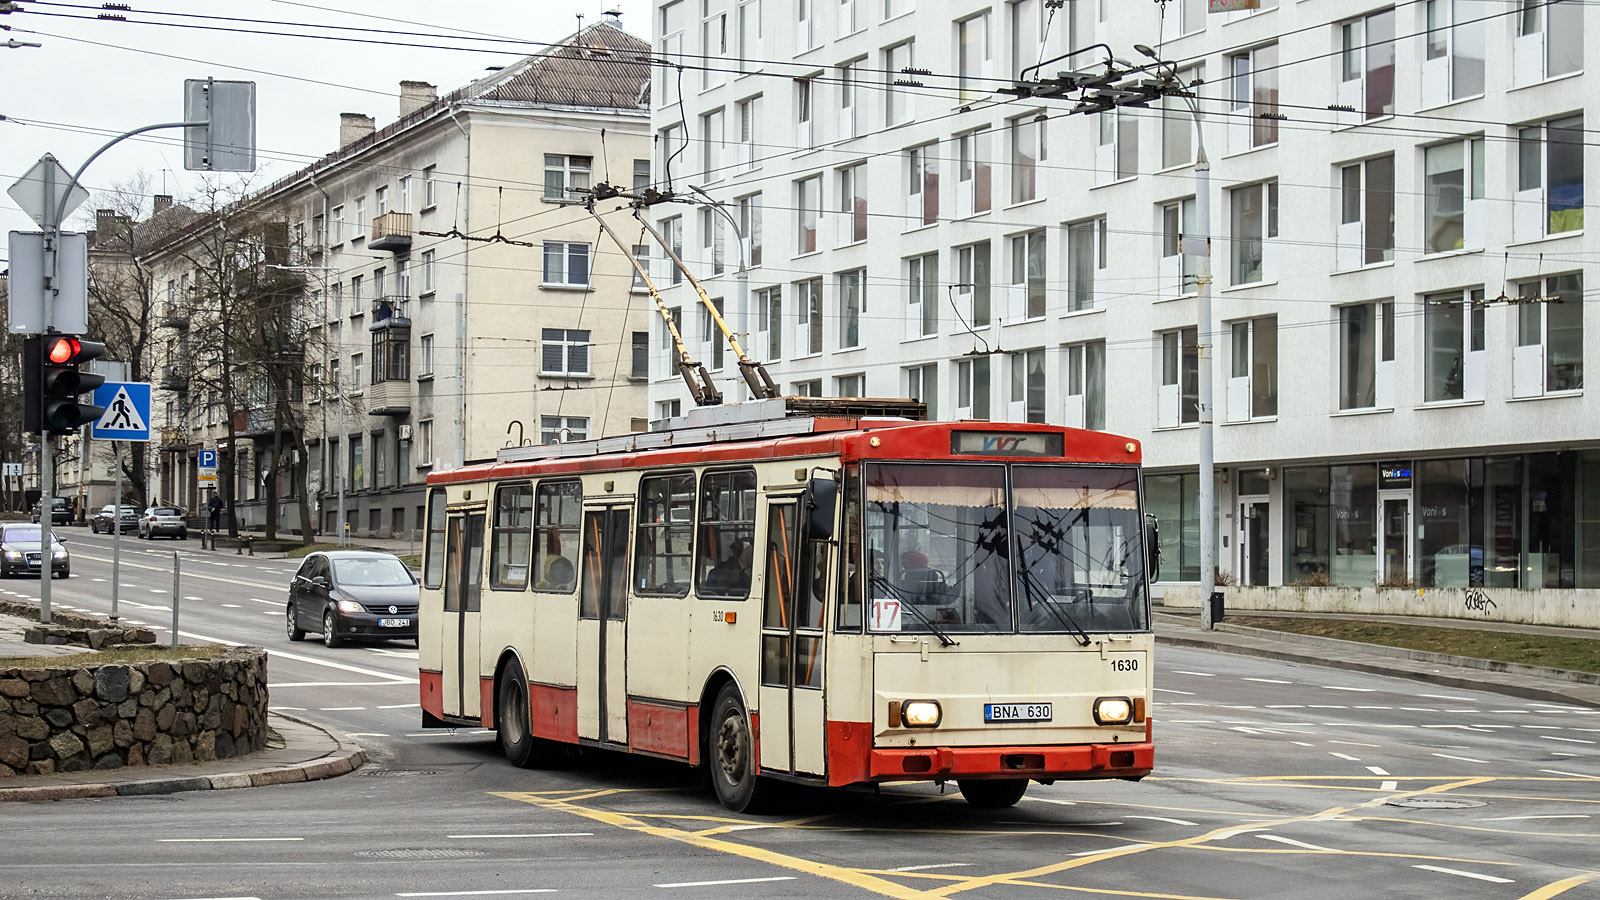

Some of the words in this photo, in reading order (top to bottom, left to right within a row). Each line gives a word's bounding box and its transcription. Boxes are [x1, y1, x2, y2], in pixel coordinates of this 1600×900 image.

[203, 452, 213, 466] P
[713, 610, 724, 622] 1630
[873, 601, 899, 628] 17
[1111, 659, 1138, 671] 1630
[993, 706, 1019, 718] BNA
[1028, 705, 1049, 717] 630
